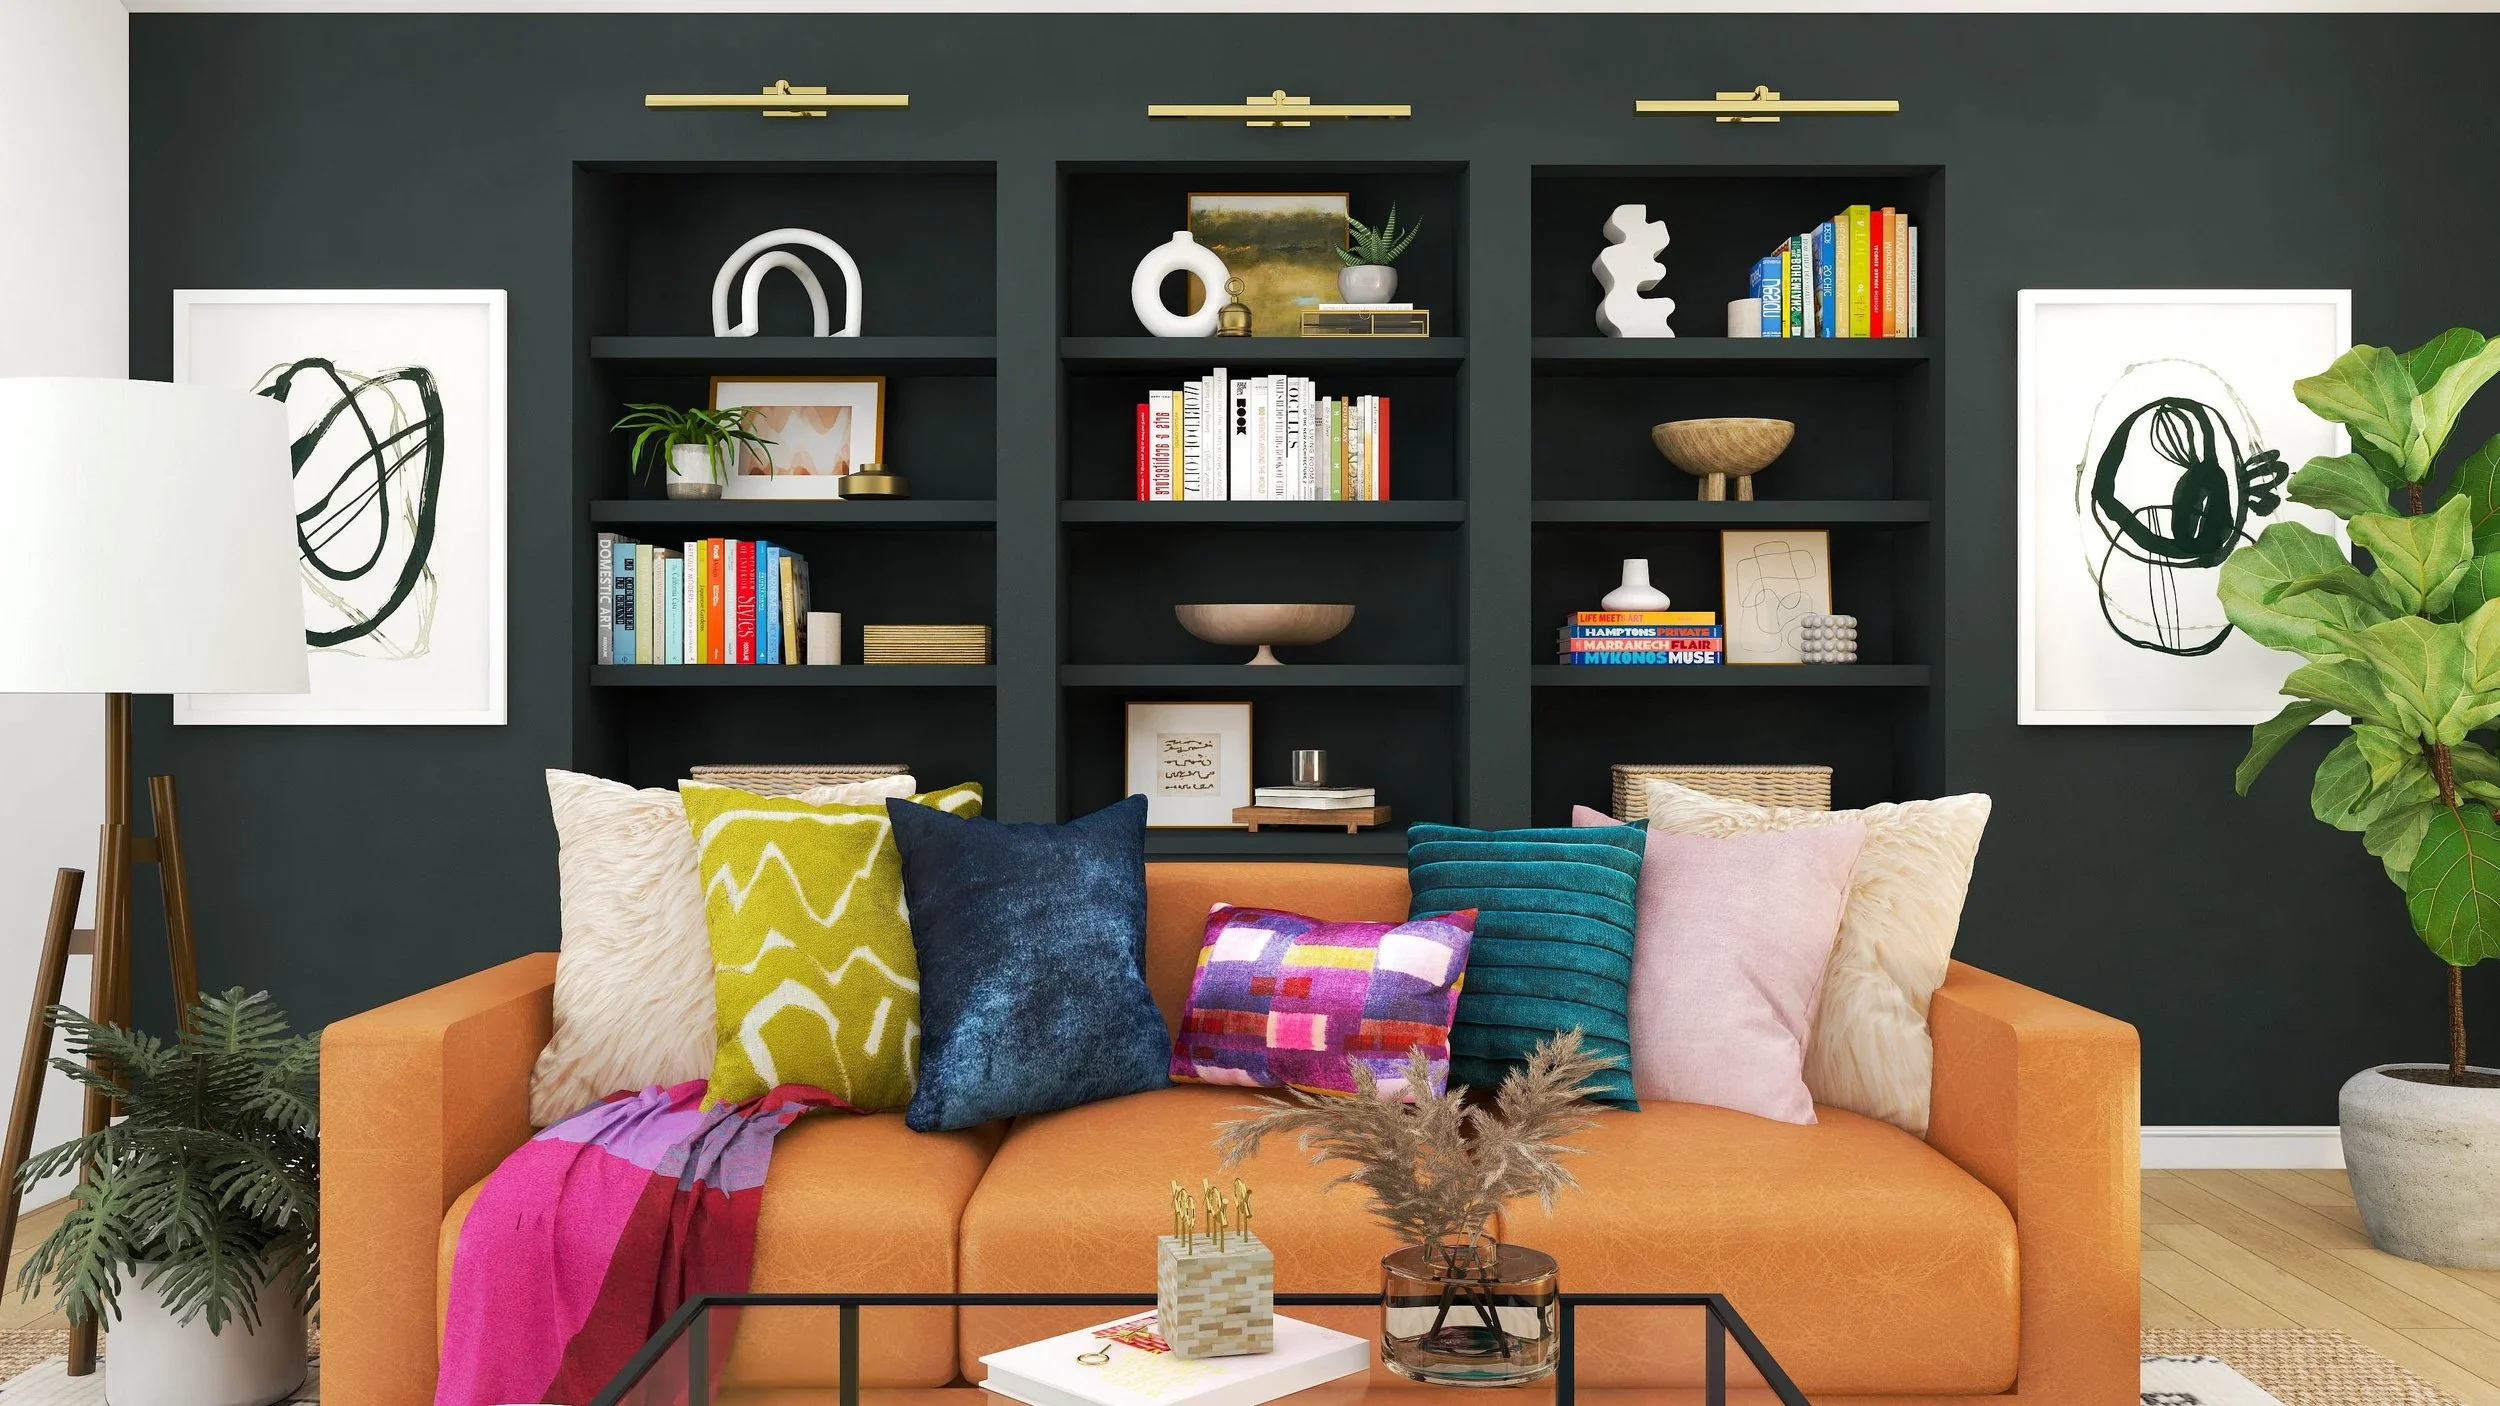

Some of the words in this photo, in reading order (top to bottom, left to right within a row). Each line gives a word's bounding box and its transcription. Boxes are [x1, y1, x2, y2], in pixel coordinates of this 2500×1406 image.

[1237, 399, 1246, 435] BOOK
[1289, 388, 1299, 449] OCULUS
[599, 540, 611, 605] DOMESTIC
[625, 559, 634, 570] LE
[616, 577, 624, 589] LE
[672, 572, 680, 597] California
[616, 595, 624, 624] GRAND
[625, 577, 634, 630] CORBUSIER
[600, 607, 611, 629] ART
[737, 596, 755, 637] Styles
[1580, 614, 1597, 623] LIFE
[1599, 614, 1625, 622] MEETS
[1585, 628, 1656, 636] HAMPTONS
[1658, 628, 1710, 636] PRIVATE
[1584, 641, 1669, 650] MARRAKECH
[1671, 640, 1711, 650] FLAIR
[1585, 652, 1667, 664] MYKONOS
[1669, 652, 1714, 664] MUSE
